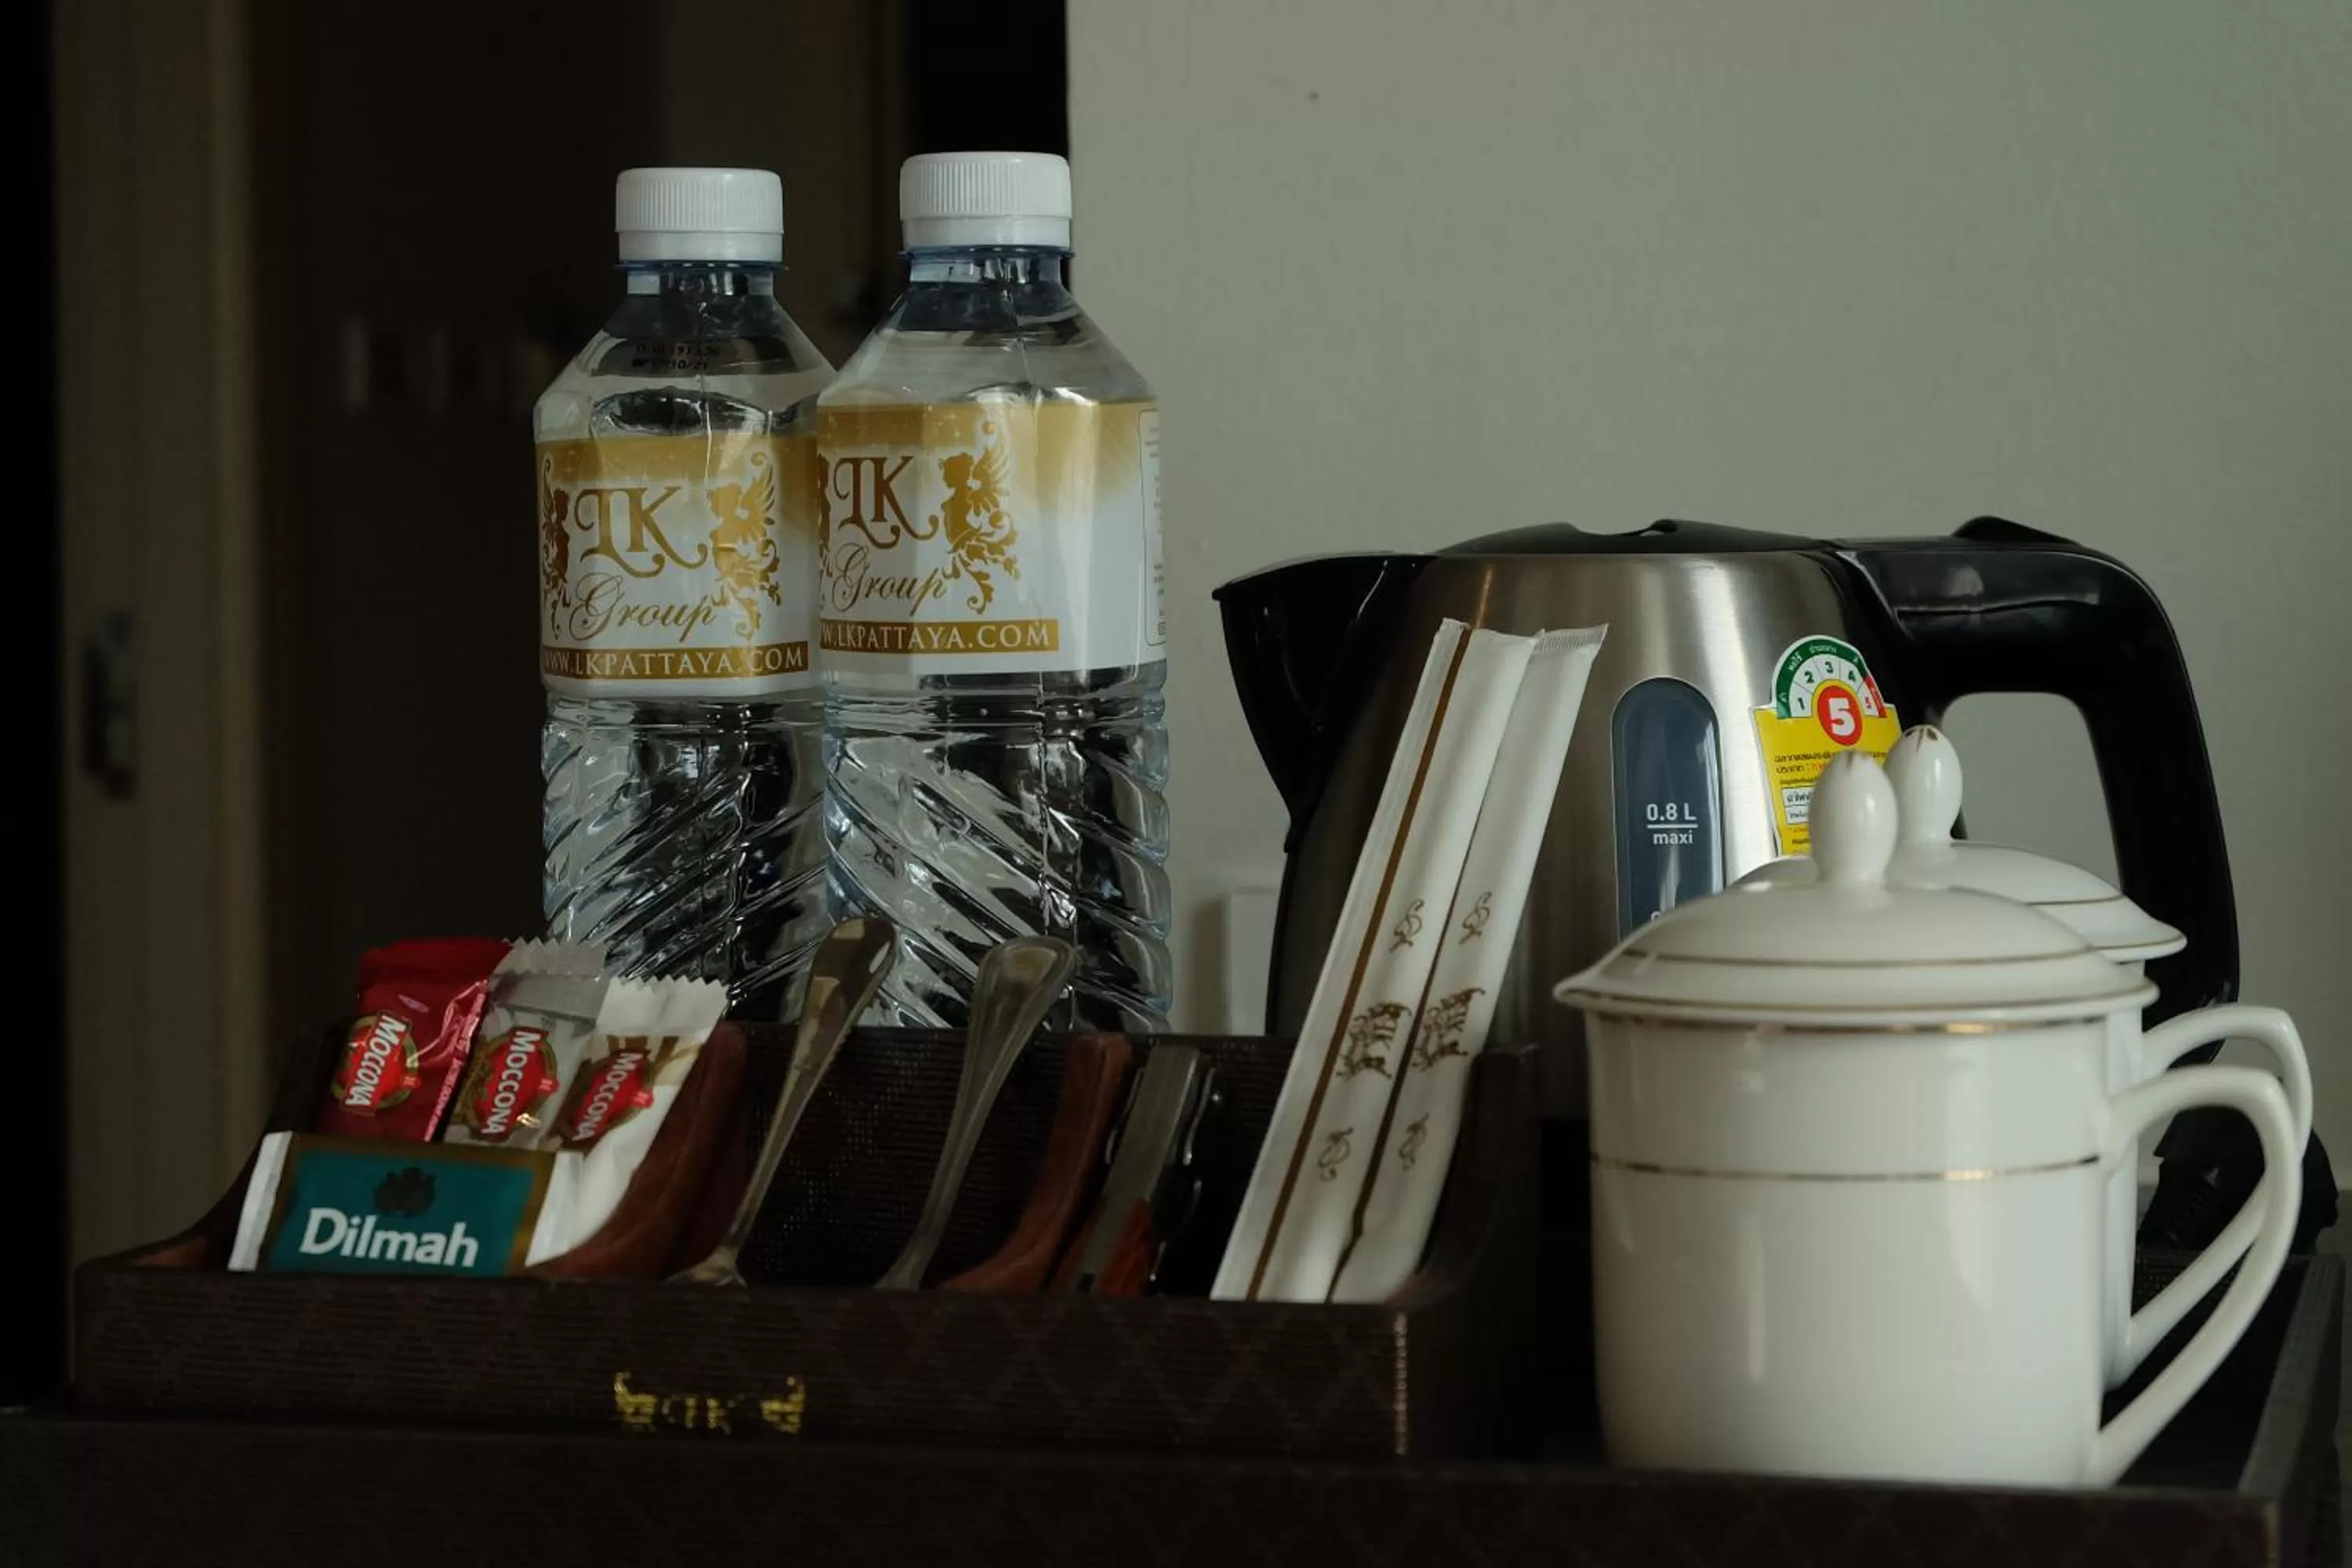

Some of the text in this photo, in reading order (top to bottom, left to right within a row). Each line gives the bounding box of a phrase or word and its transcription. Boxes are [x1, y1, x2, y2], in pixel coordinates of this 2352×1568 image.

[575, 486, 708, 578] LK
[833, 456, 939, 550] LK
[569, 572, 717, 642] Group
[832, 543, 947, 617] Group
[1796, 698, 1805, 711] 1
[1804, 671, 1815, 684] 2
[1824, 661, 1834, 674] 3
[1848, 670, 1857, 682] 4
[1864, 696, 1871, 709] 5
[1828, 698, 1857, 736] 5
[1646, 804, 1697, 822] 0.8 L
[1653, 829, 1693, 845] maxi
[480, 1029, 542, 1136] MOCCONA
[298, 1207, 480, 1269] Dilmah
